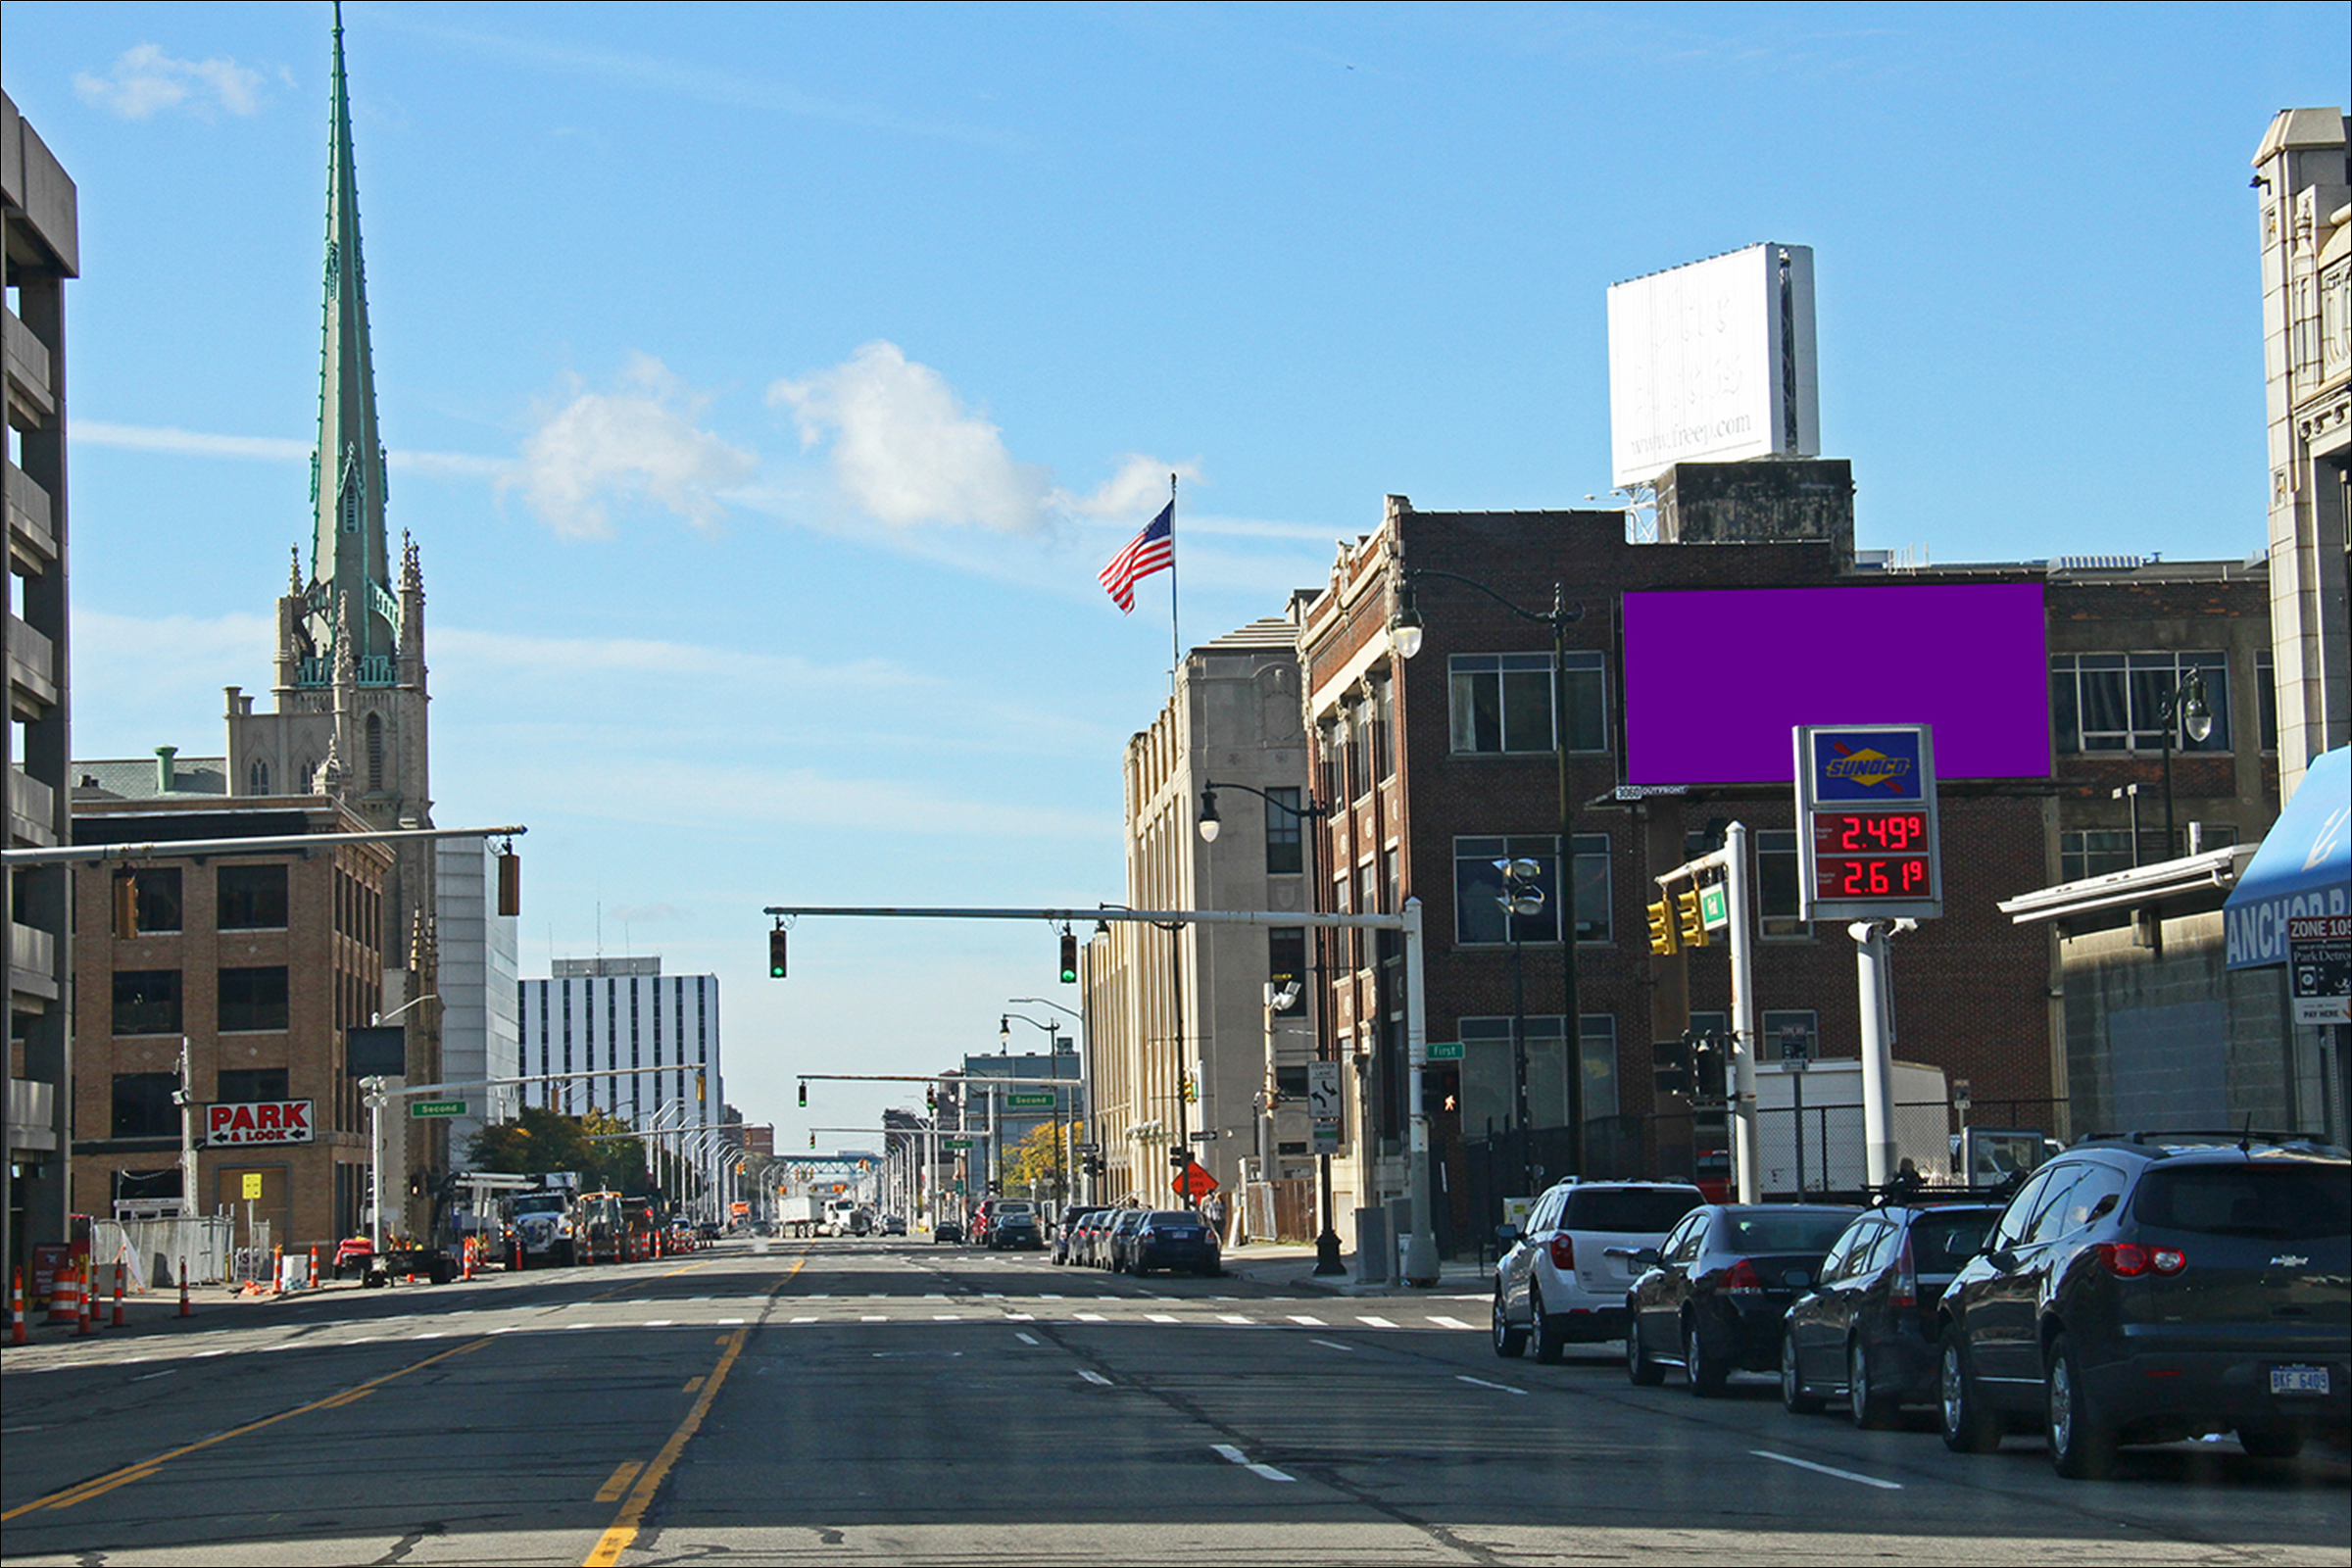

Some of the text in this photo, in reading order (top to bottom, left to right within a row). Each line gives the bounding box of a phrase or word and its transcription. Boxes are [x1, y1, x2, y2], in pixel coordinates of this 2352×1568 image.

[1630, 414, 1751, 456] www.freep.com
[1830, 760, 1908, 775] SUNOCO
[2290, 920, 2328, 938] ZONE
[2293, 950, 2351, 962] ParkDetro
[2319, 1008, 2338, 1017] HERE
[422, 1103, 458, 1113] Second
[211, 1102, 309, 1131] PARK
[246, 1130, 287, 1142] LOCK
